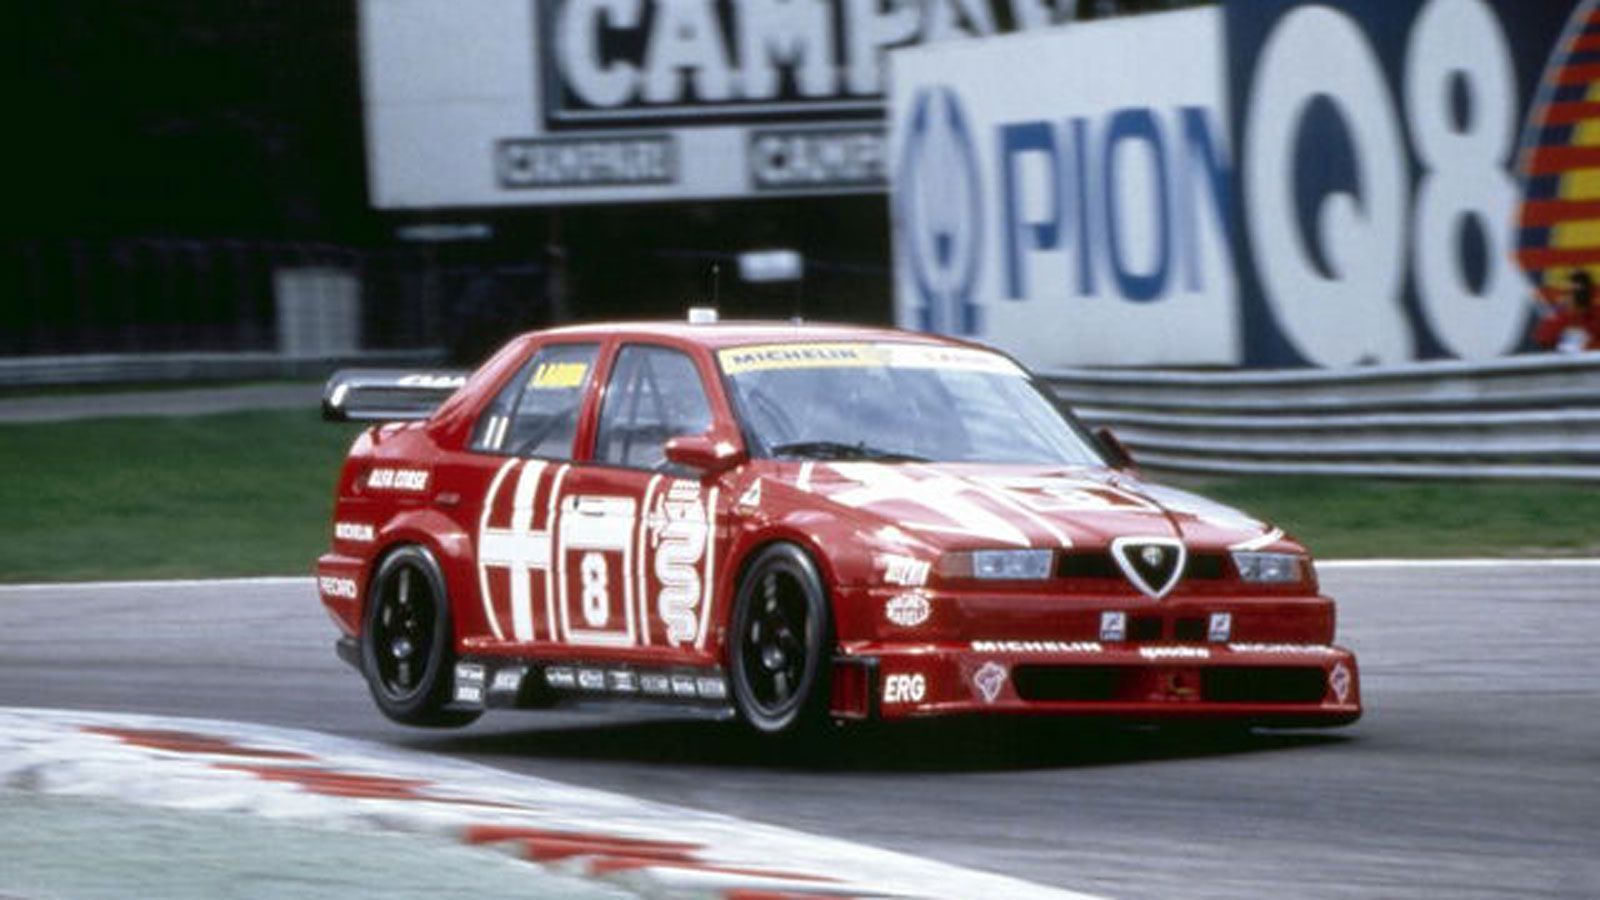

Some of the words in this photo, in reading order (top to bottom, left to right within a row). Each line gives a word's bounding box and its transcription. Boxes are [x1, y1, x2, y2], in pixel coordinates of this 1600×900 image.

[1243, 0, 1528, 369] Q8
[731, 348, 858, 366] MICHELIN
[581, 552, 610, 628] 8
[971, 641, 1103, 653] MICHELIN
[883, 673, 926, 703] ERG
